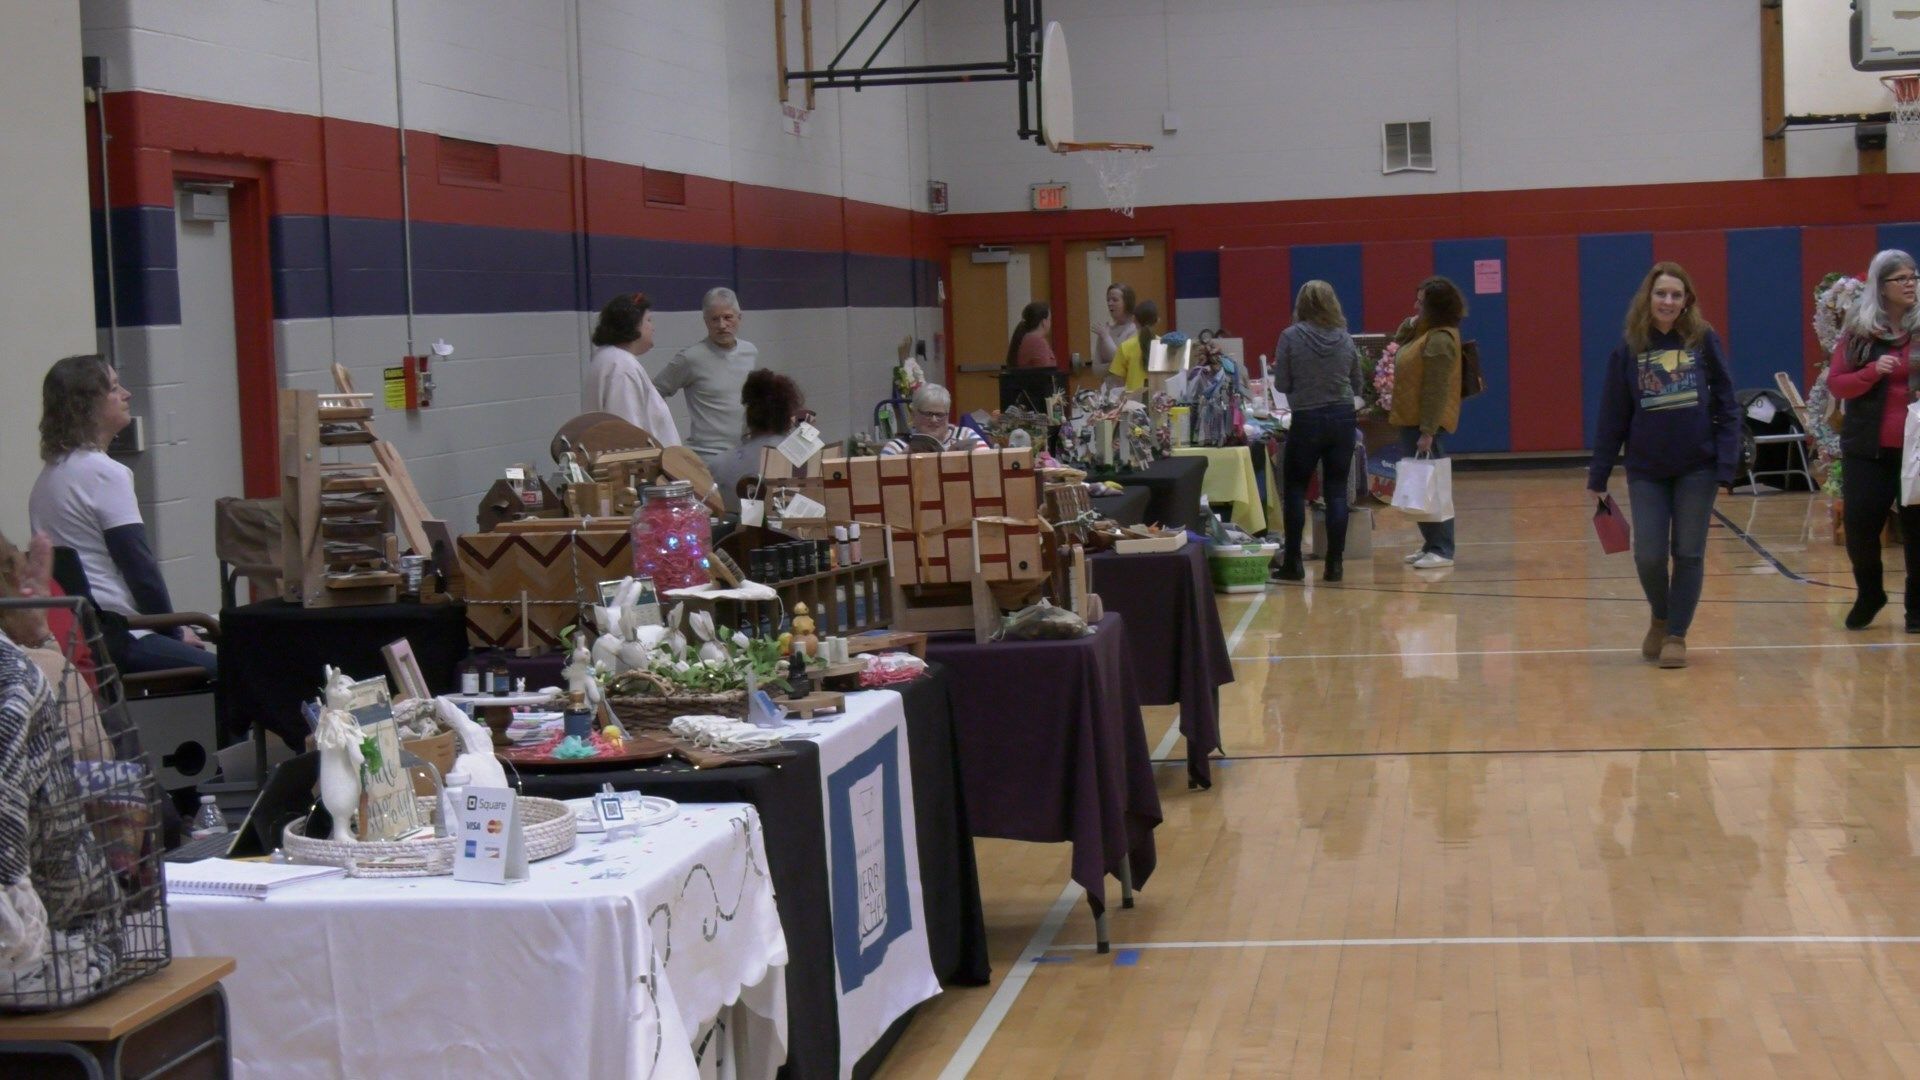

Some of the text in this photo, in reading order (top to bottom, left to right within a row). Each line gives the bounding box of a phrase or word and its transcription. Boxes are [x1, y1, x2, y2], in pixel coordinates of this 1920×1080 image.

[1039, 187, 1063, 209] EXIT
[479, 798, 507, 811] Square
[466, 821, 481, 831] VISA
